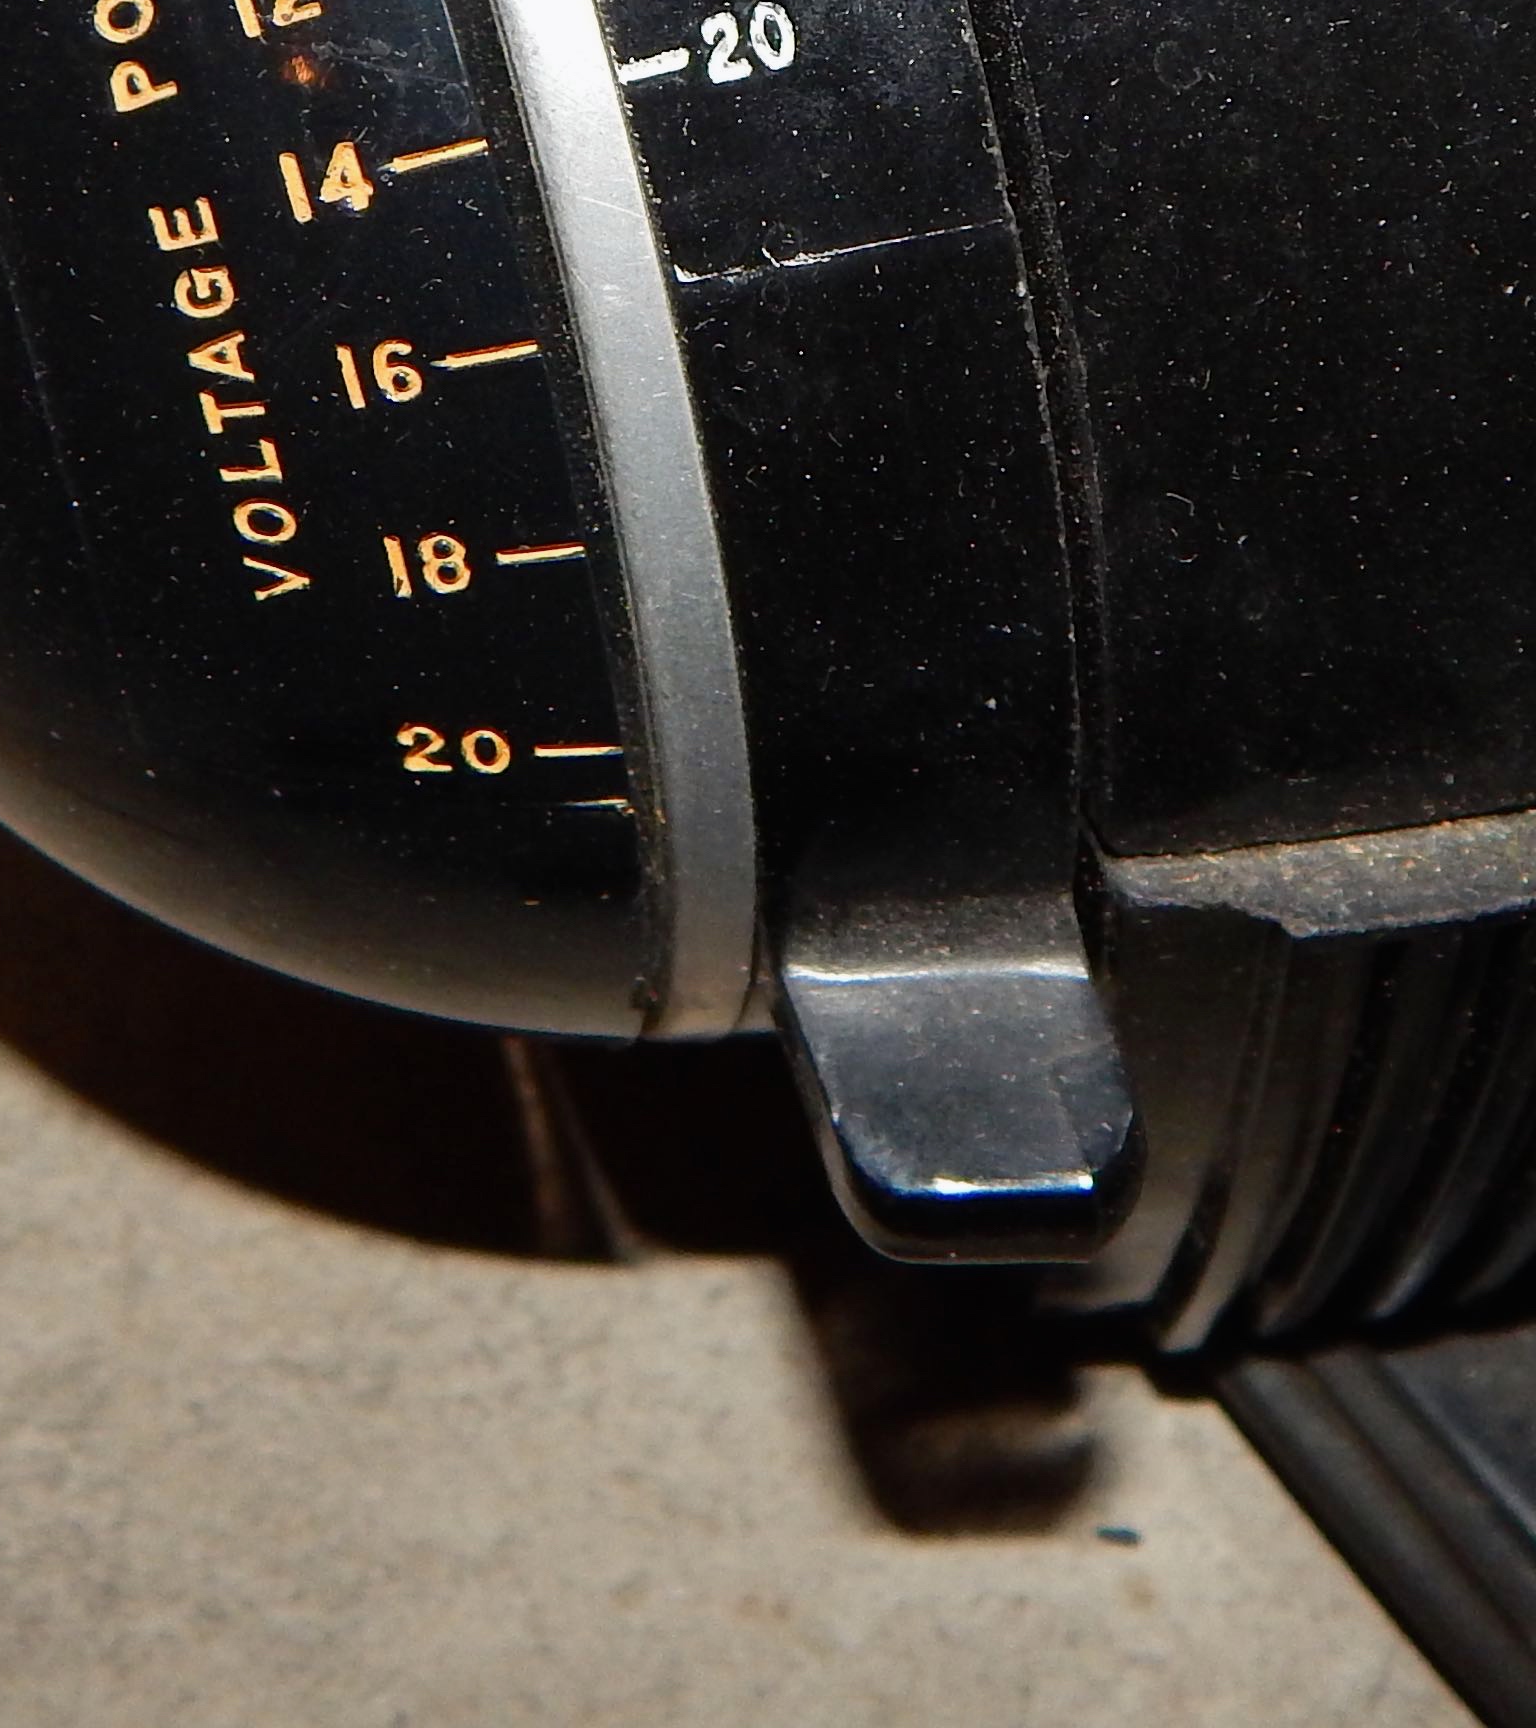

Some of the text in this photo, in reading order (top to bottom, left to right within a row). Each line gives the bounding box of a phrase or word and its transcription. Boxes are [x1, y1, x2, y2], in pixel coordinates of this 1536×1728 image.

[701, 0, 797, 84] 20
[278, 140, 374, 223] 14
[148, 195, 315, 602] VOLTAGE
[336, 339, 424, 409] 16
[385, 531, 473, 598] 18
[396, 725, 513, 776] 20
